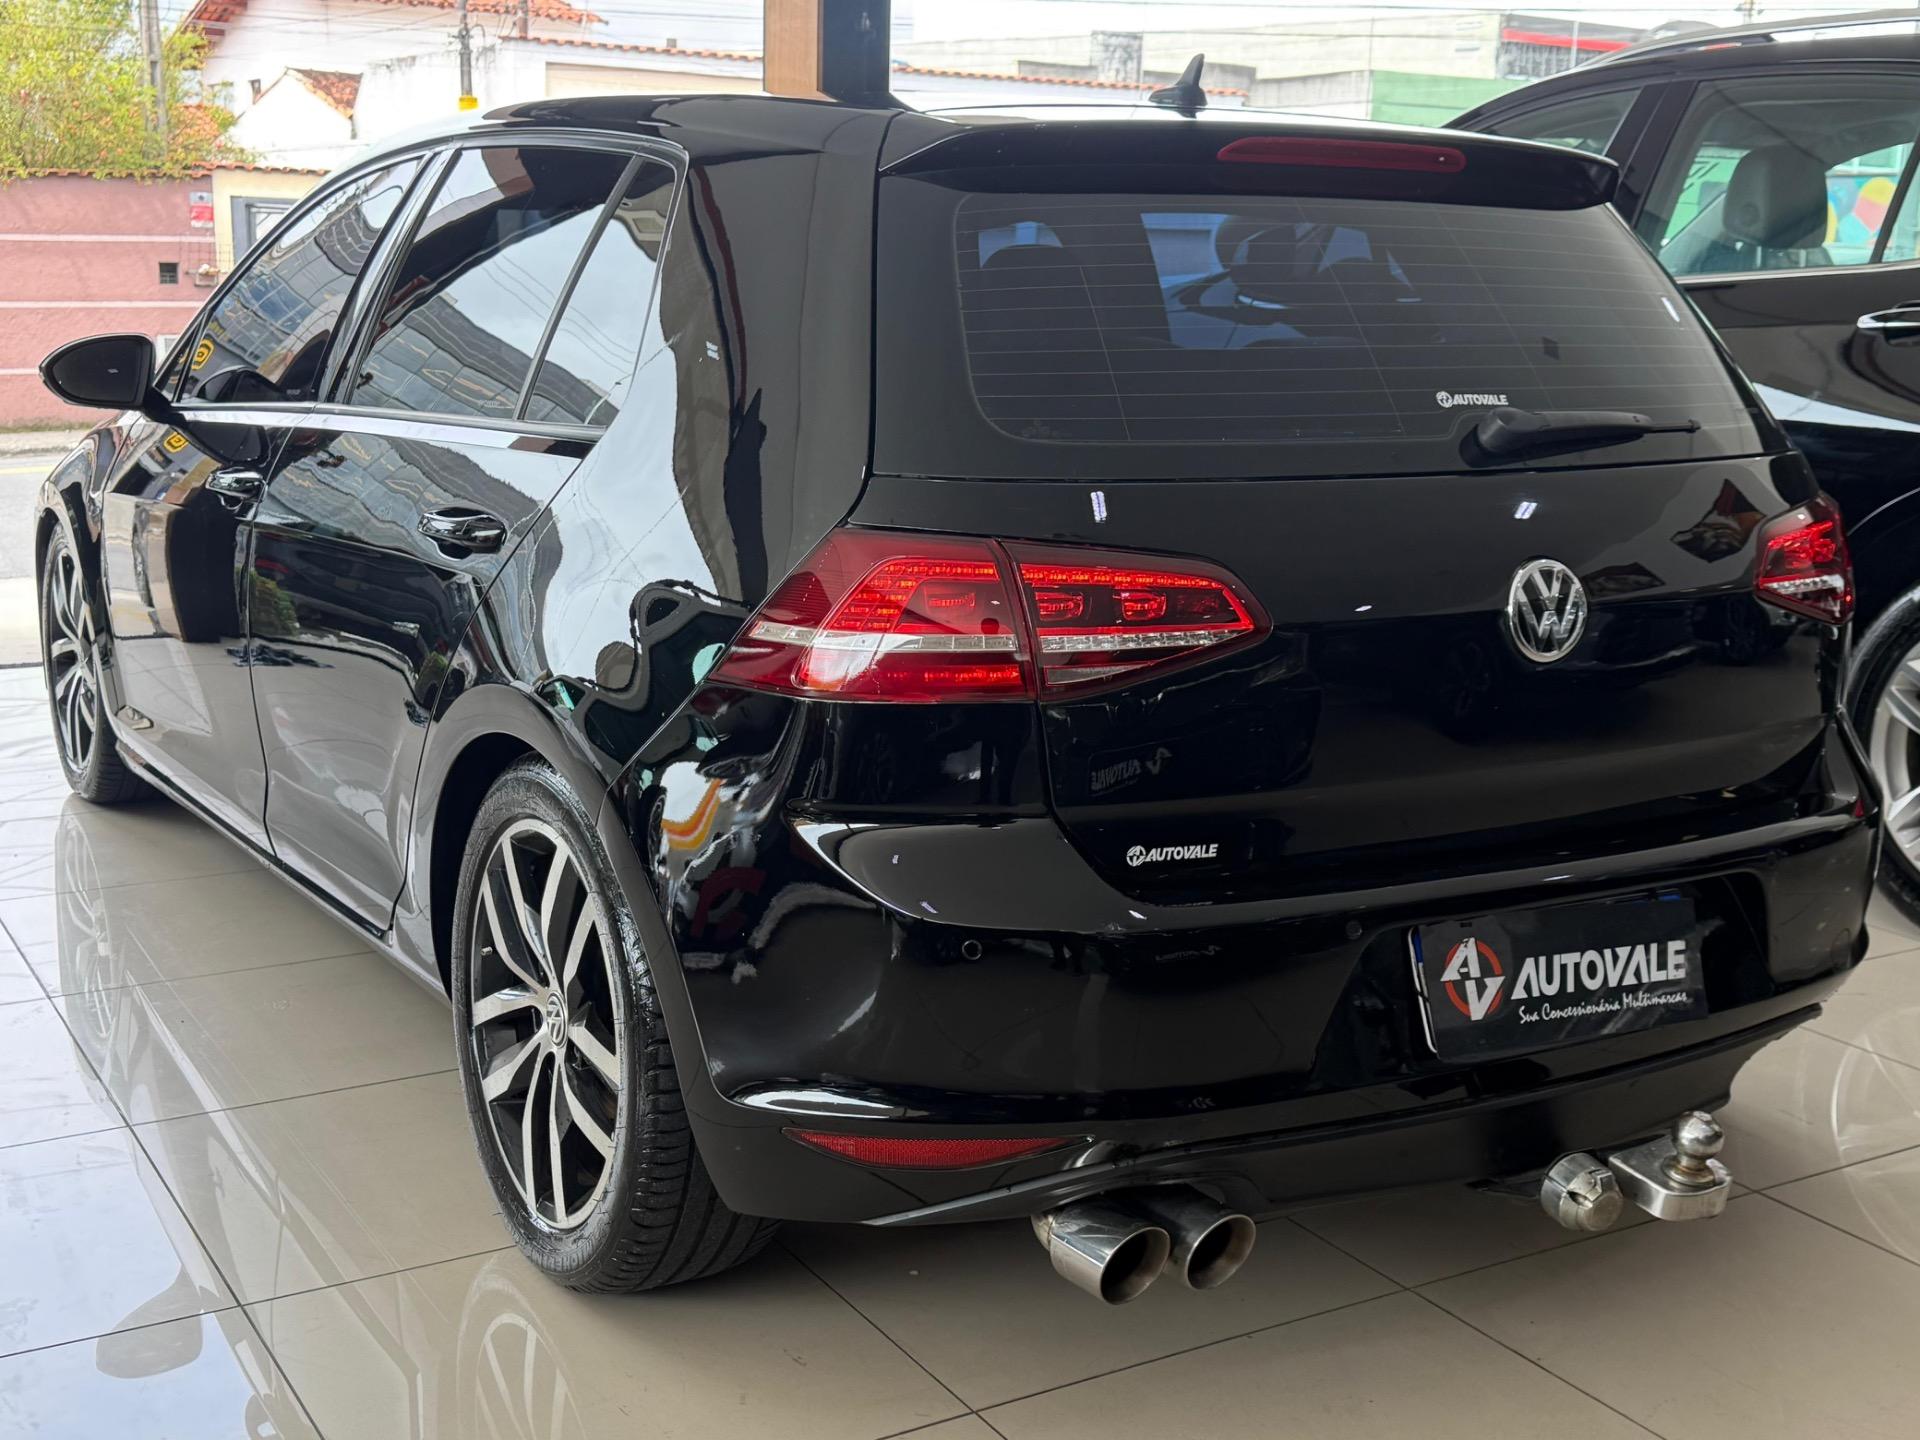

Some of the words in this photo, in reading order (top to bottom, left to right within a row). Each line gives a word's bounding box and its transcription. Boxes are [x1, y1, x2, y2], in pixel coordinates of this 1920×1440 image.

[1453, 394, 1509, 406] AUTOVALE
[1145, 844, 1218, 861] AUTOVALE
[1510, 940, 1687, 1000] AUTOVALE
[1518, 1005, 1540, 1024] Sua
[1541, 999, 1622, 1021] Concessionária
[1622, 990, 1688, 1010] Multimarcas
